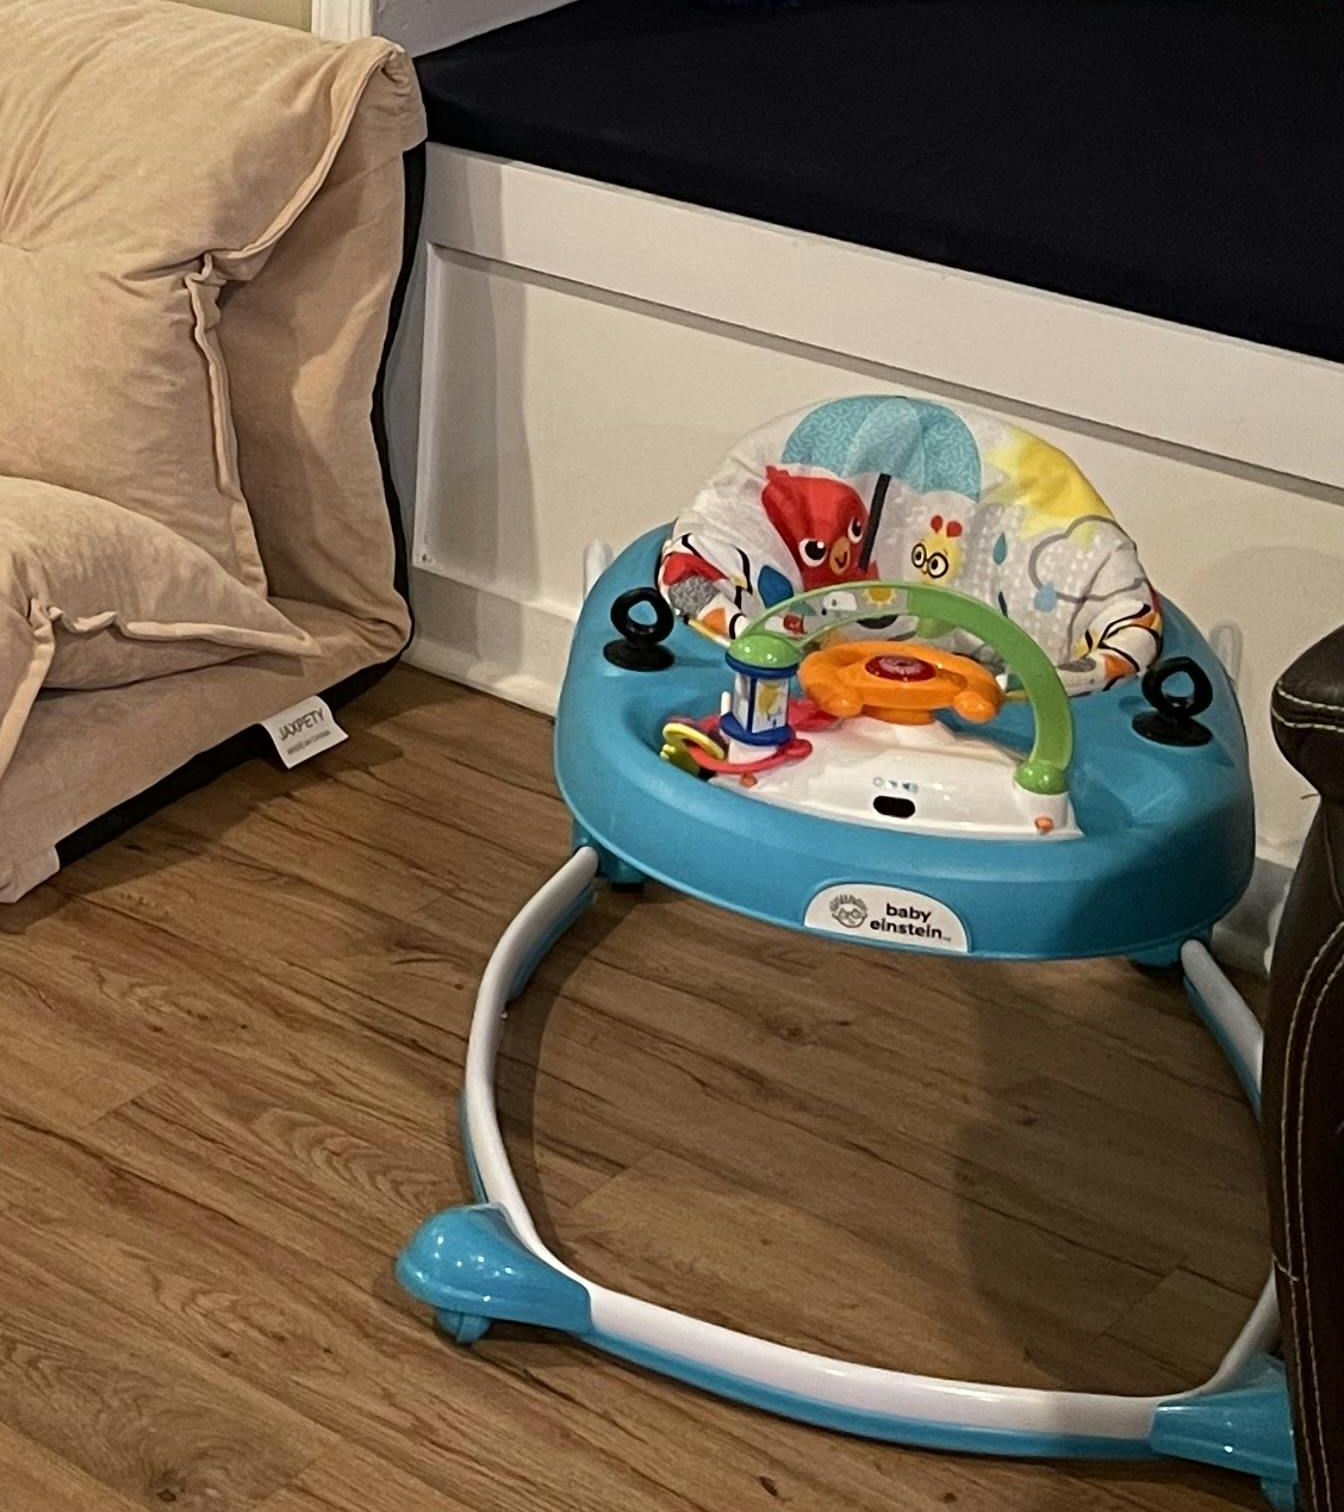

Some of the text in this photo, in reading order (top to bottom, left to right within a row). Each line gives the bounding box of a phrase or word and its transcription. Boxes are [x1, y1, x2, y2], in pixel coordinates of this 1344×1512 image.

[278, 707, 325, 742] JAXPETY
[886, 902, 932, 923] baby
[870, 917, 942, 939] einstein
